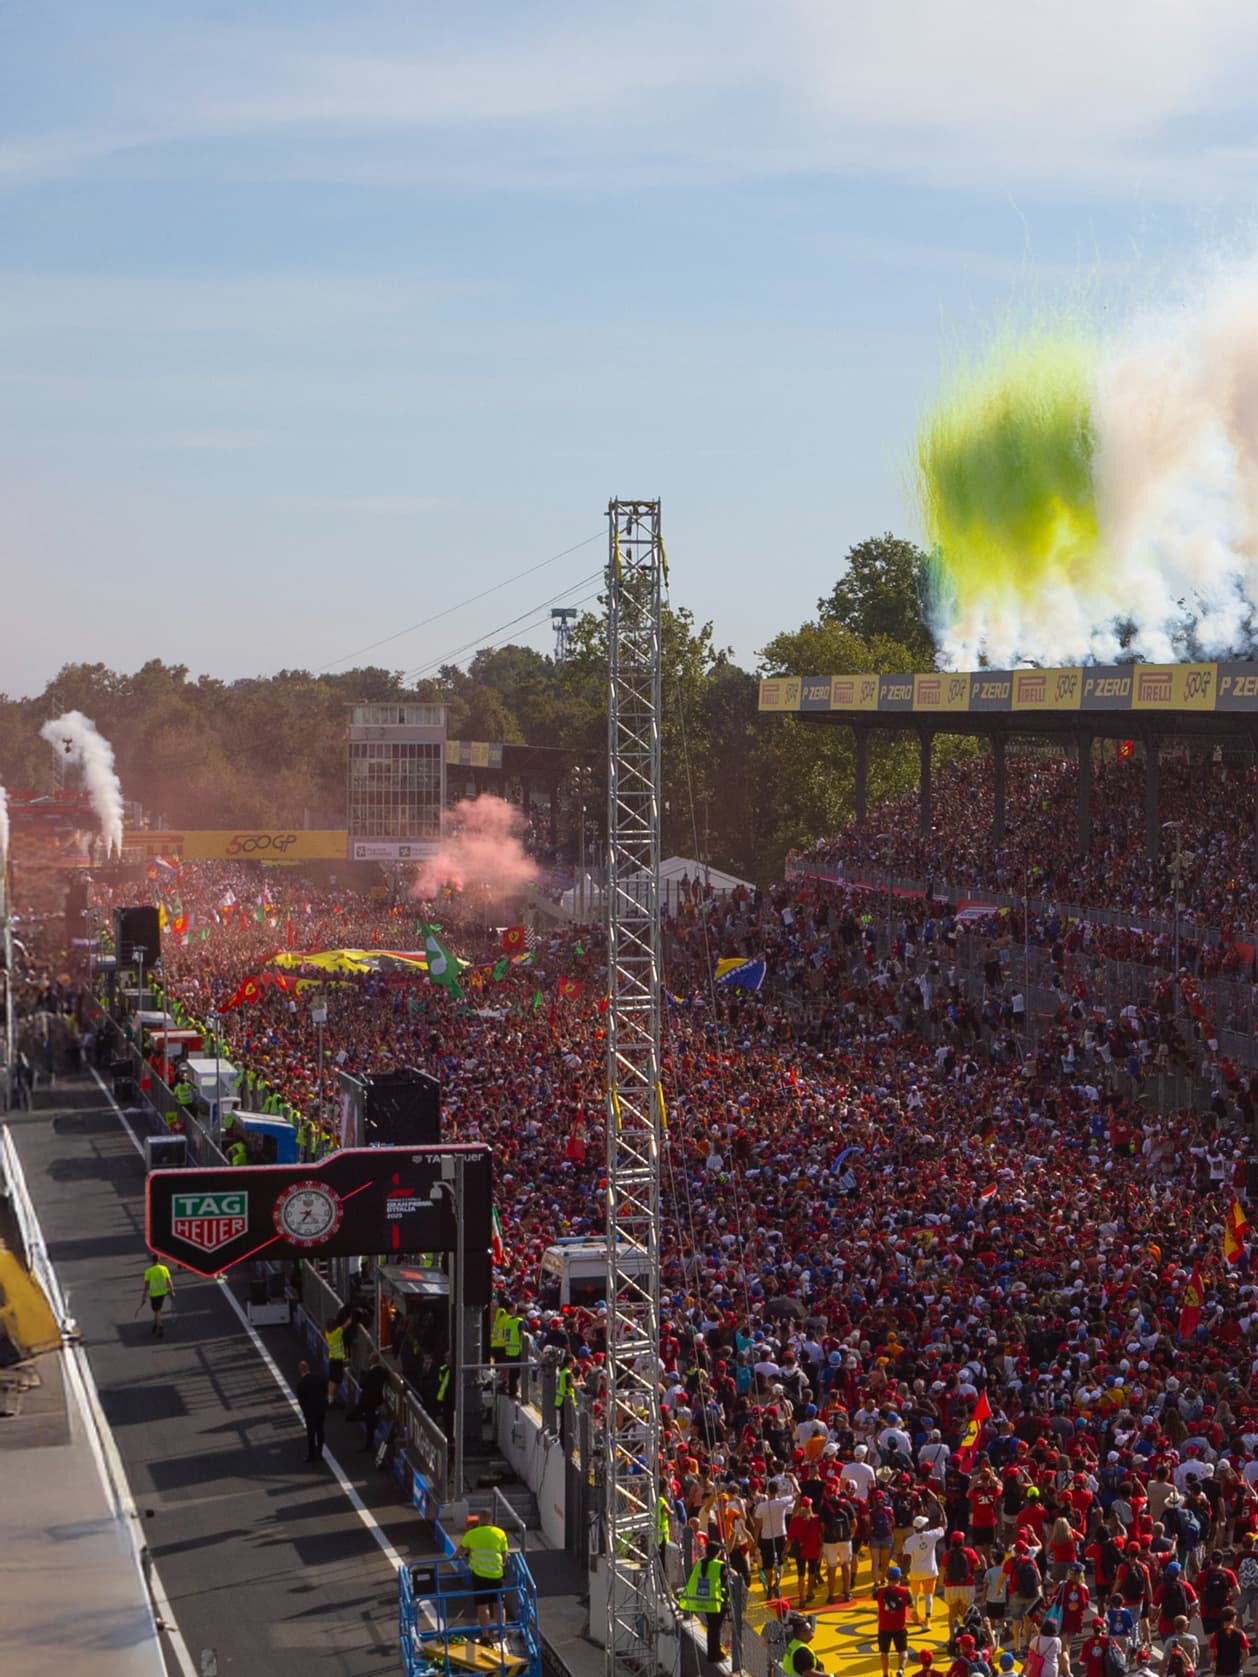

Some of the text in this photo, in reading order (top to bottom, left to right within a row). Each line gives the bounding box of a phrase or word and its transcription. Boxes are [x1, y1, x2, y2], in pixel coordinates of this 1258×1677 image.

[972, 682, 1010, 698] P ZERO
[1018, 676, 1046, 703] PIRELLI
[1084, 678, 1131, 696] P ZERO
[1138, 672, 1173, 702] PIRELLI
[1219, 676, 1231, 696] P
[226, 834, 297, 855] 500GP
[178, 1196, 241, 1216] TAG
[177, 1219, 243, 1247] HEUER
